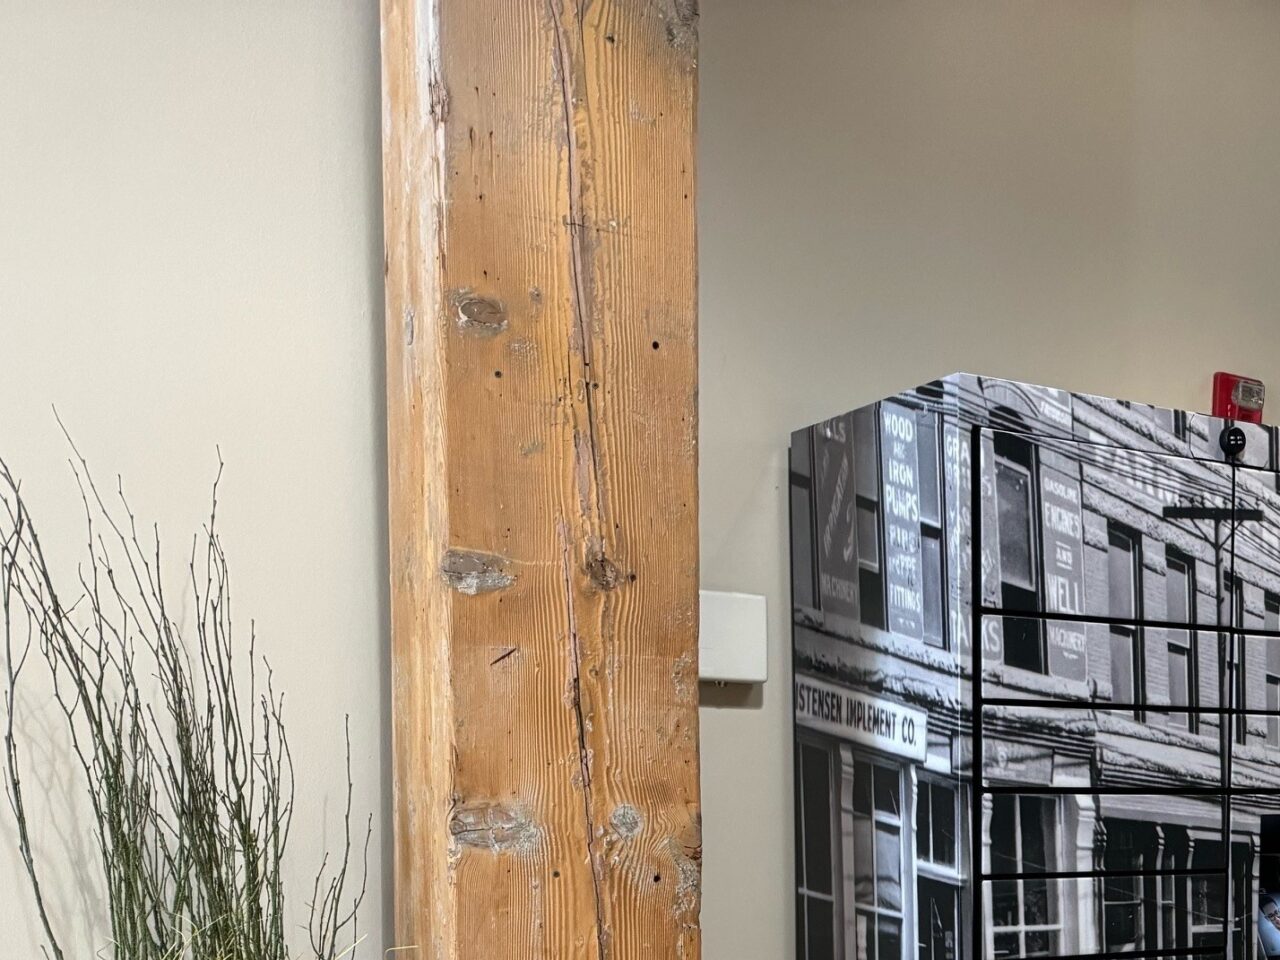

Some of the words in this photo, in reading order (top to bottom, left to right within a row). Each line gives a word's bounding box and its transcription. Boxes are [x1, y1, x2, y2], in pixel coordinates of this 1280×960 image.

[883, 411, 913, 443] WOOD
[888, 458, 914, 488] IRON
[1043, 476, 1078, 503] GASOLINE
[886, 484, 919, 522] PUMPS
[1044, 501, 1080, 540] ENGINES
[1055, 546, 1073, 565] AND
[889, 583, 921, 613] FITTINGS
[1046, 572, 1079, 614] WELL
[949, 609, 1001, 653] TAKS
[846, 697, 897, 740] IMPLEMENT
[901, 715, 917, 747] CO.
